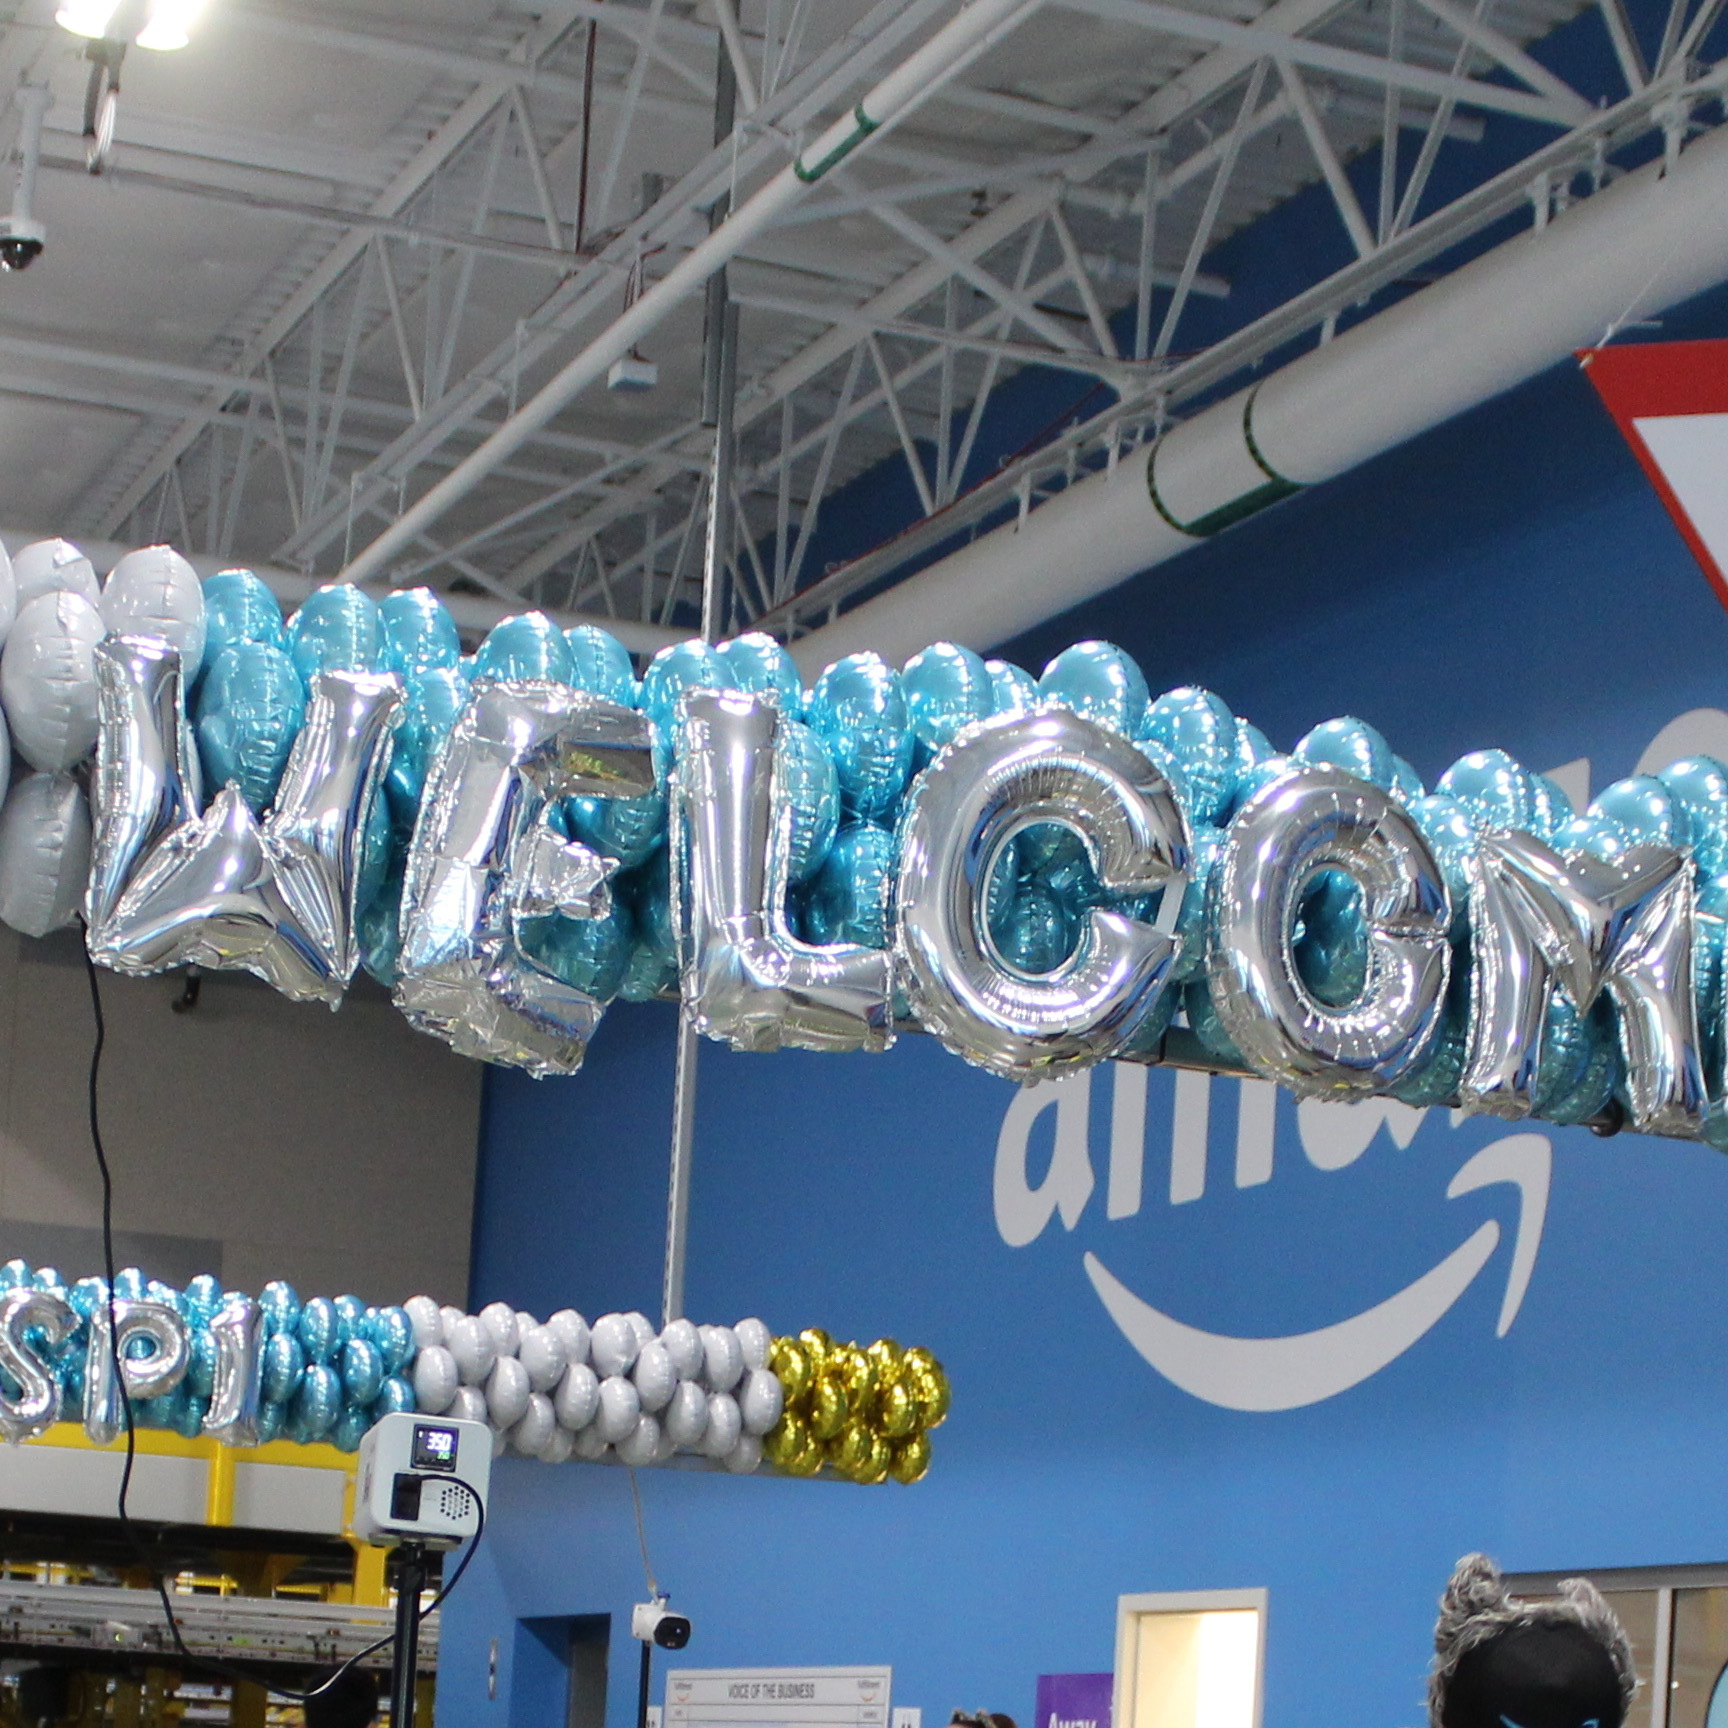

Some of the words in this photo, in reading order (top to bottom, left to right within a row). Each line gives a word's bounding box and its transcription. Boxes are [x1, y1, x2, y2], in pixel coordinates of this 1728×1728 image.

[728, 1683, 749, 1699] VOICE
[750, 1683, 760, 1699] OF
[762, 1683, 776, 1699] THE
[777, 1683, 816, 1699] BUSINESS
